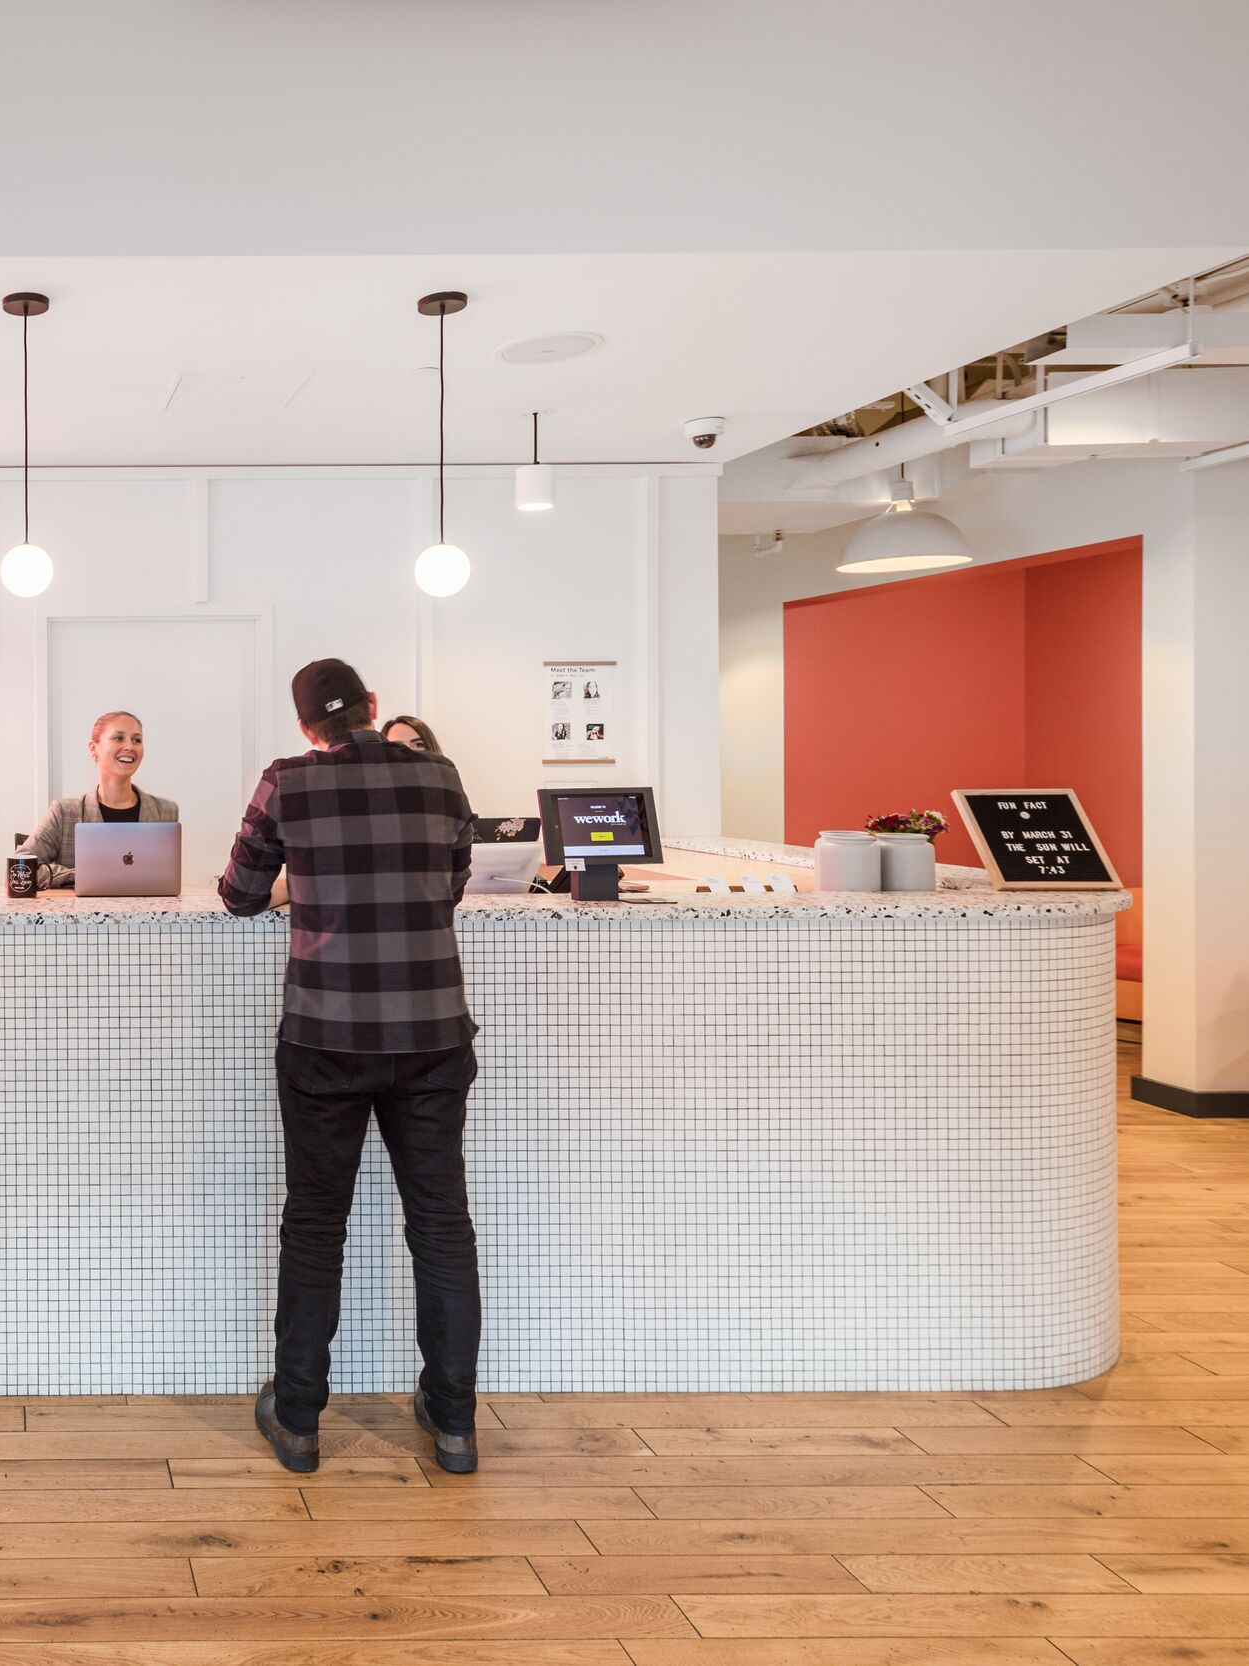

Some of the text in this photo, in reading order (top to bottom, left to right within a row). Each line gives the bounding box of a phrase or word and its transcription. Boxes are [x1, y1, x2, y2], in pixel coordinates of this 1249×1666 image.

[997, 801, 1048, 810] FUN FACT
[574, 811, 627, 824] wework
[1000, 831, 1073, 839] BY MARCH 31
[1005, 843, 1091, 852] THE SUN WILL
[1025, 856, 1070, 864] SET AT
